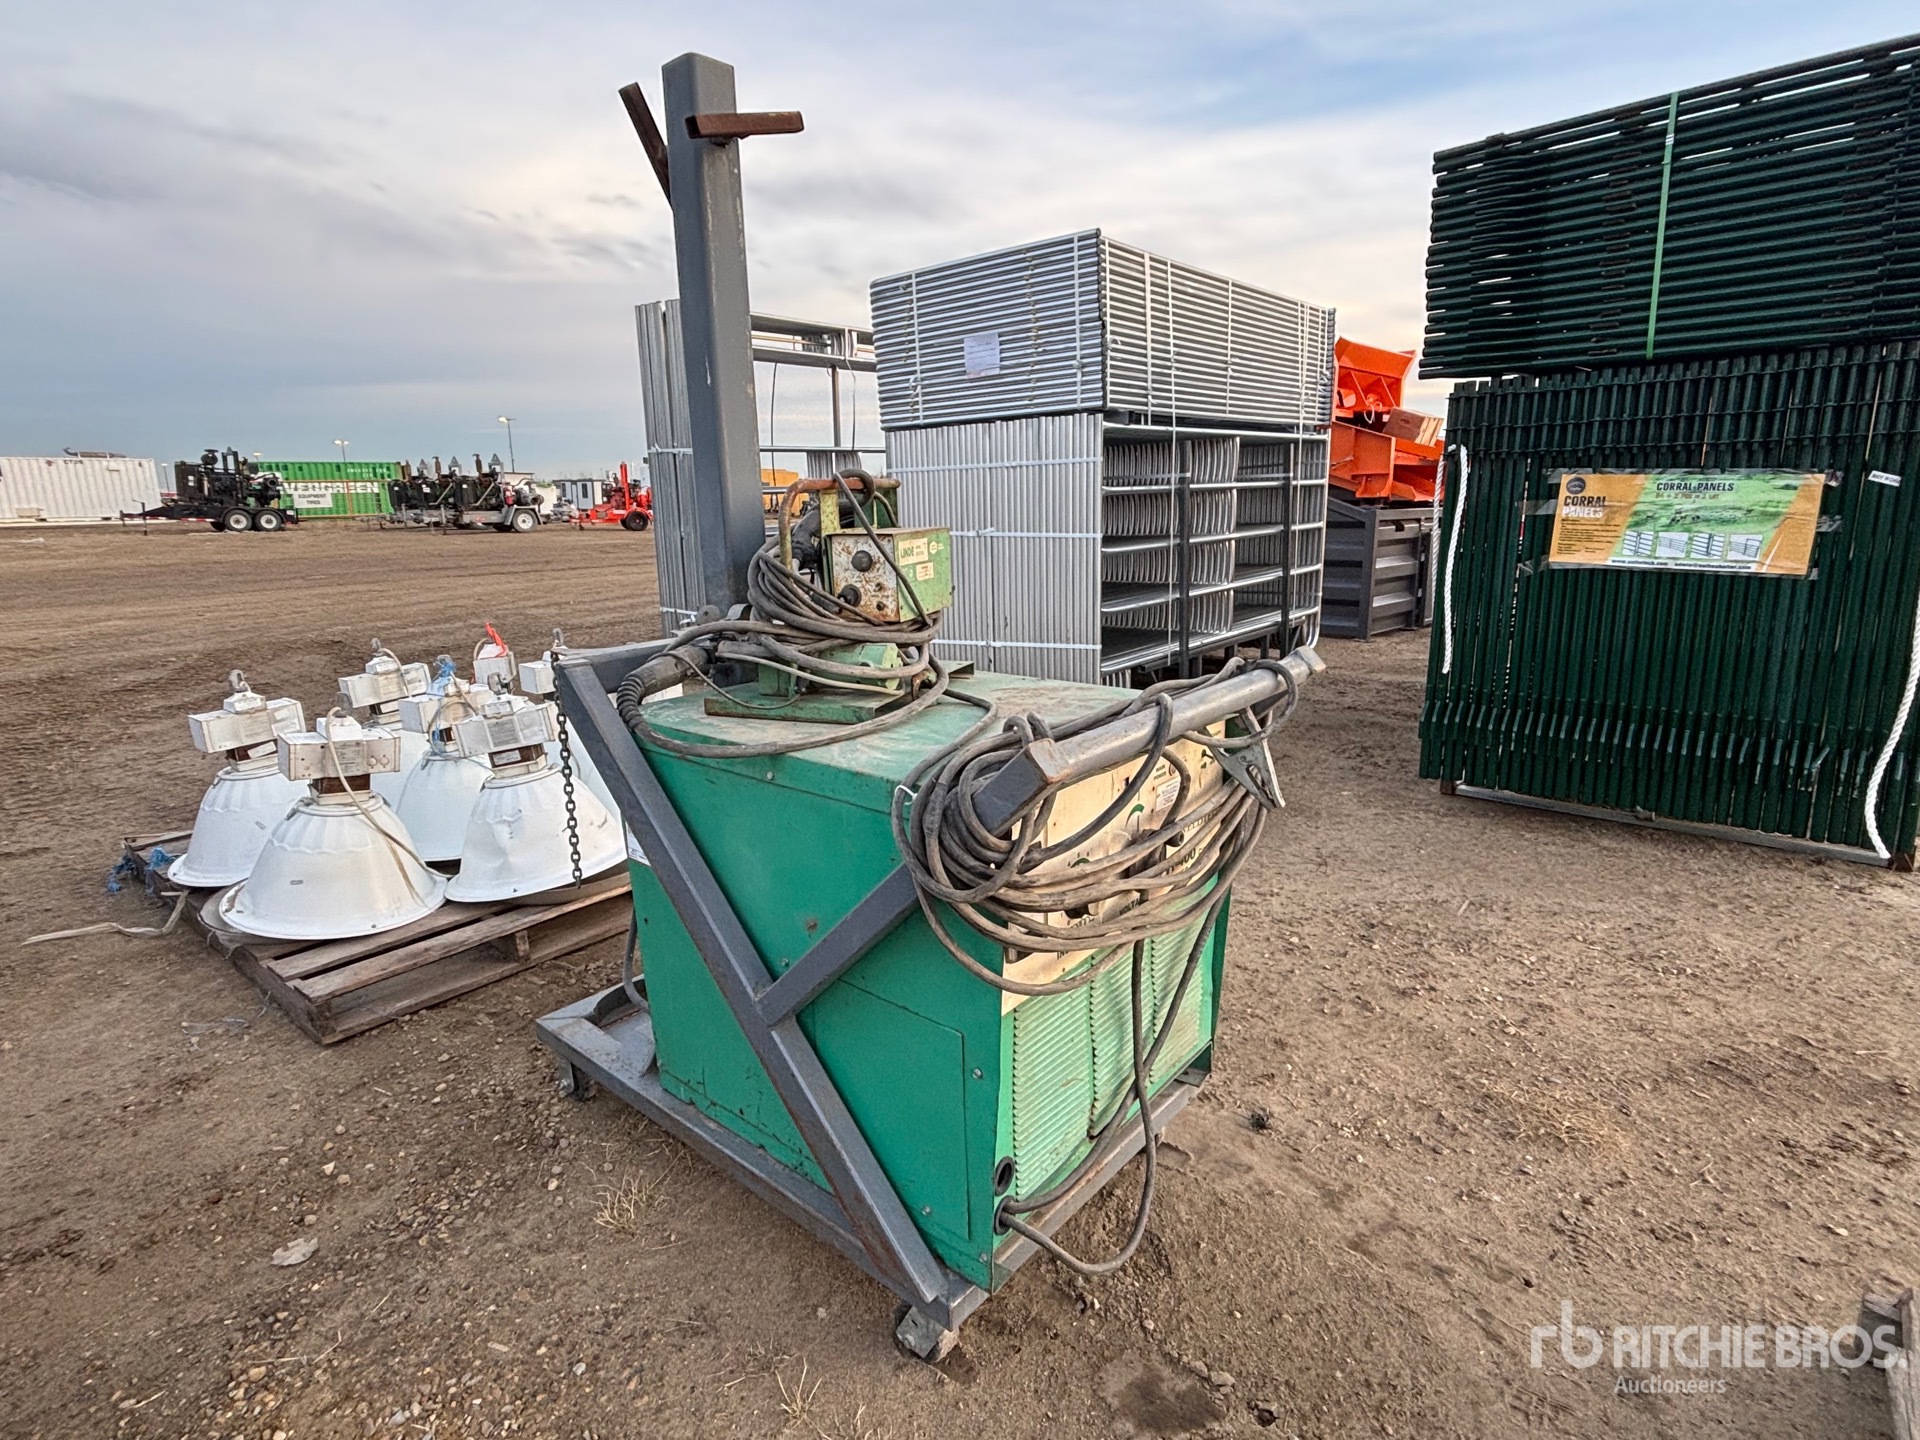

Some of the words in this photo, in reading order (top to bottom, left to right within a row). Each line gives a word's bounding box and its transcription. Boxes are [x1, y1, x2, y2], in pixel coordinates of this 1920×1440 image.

[1656, 482, 1692, 491] CORRAL
[1697, 482, 1735, 491] PANELS
[1564, 495, 1606, 507] CORRAL
[1562, 507, 1603, 518] PANELS
